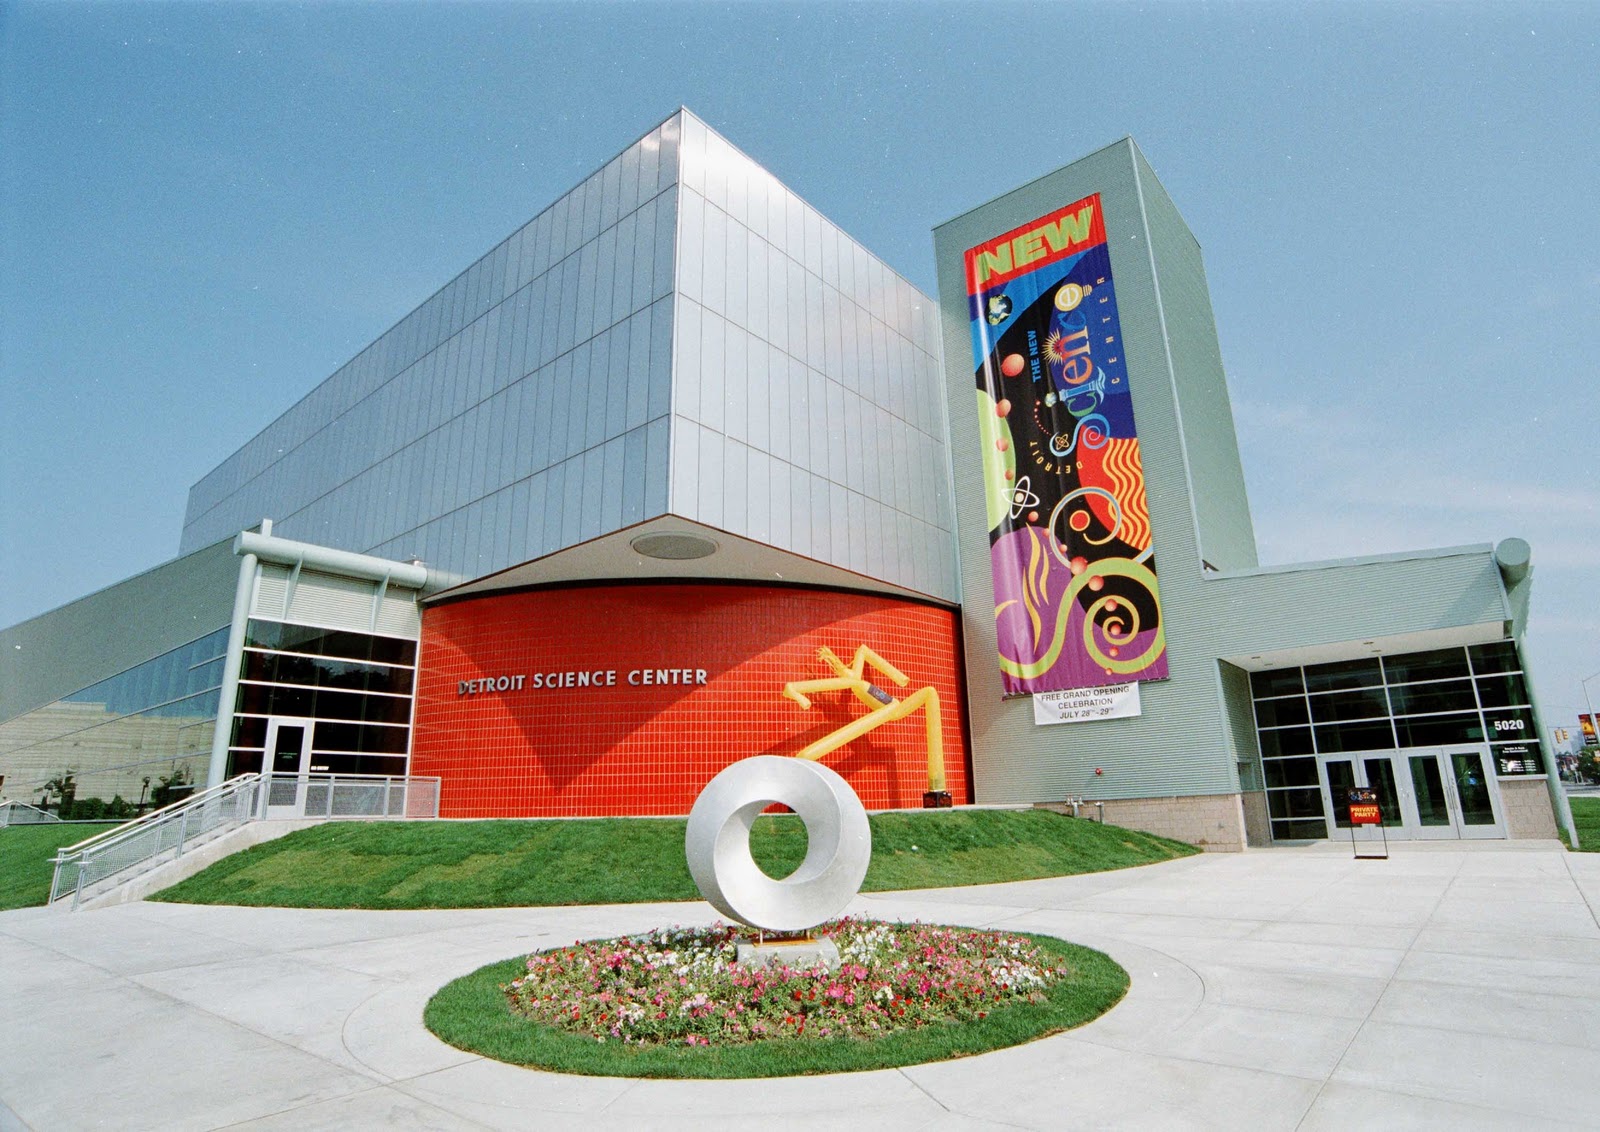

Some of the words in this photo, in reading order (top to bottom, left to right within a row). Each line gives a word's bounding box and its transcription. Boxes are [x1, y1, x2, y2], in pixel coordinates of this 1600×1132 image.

[976, 205, 1093, 285] NEW
[1097, 277, 1120, 384] CENTER
[1027, 330, 1039, 359] NEW
[1030, 361, 1042, 384] THE
[1030, 441, 1083, 475] DETROIT
[458, 674, 526, 695] DETROIT
[533, 670, 617, 689] SCIENCE
[627, 668, 708, 686] CENTER
[1041, 693, 1061, 702] FREE
[1063, 689, 1091, 699] GRAND
[1093, 685, 1130, 697] OPENING
[1058, 697, 1113, 710] CELEBRATION
[1059, 711, 1079, 720] JULY
[1494, 719, 1524, 731] 5020
